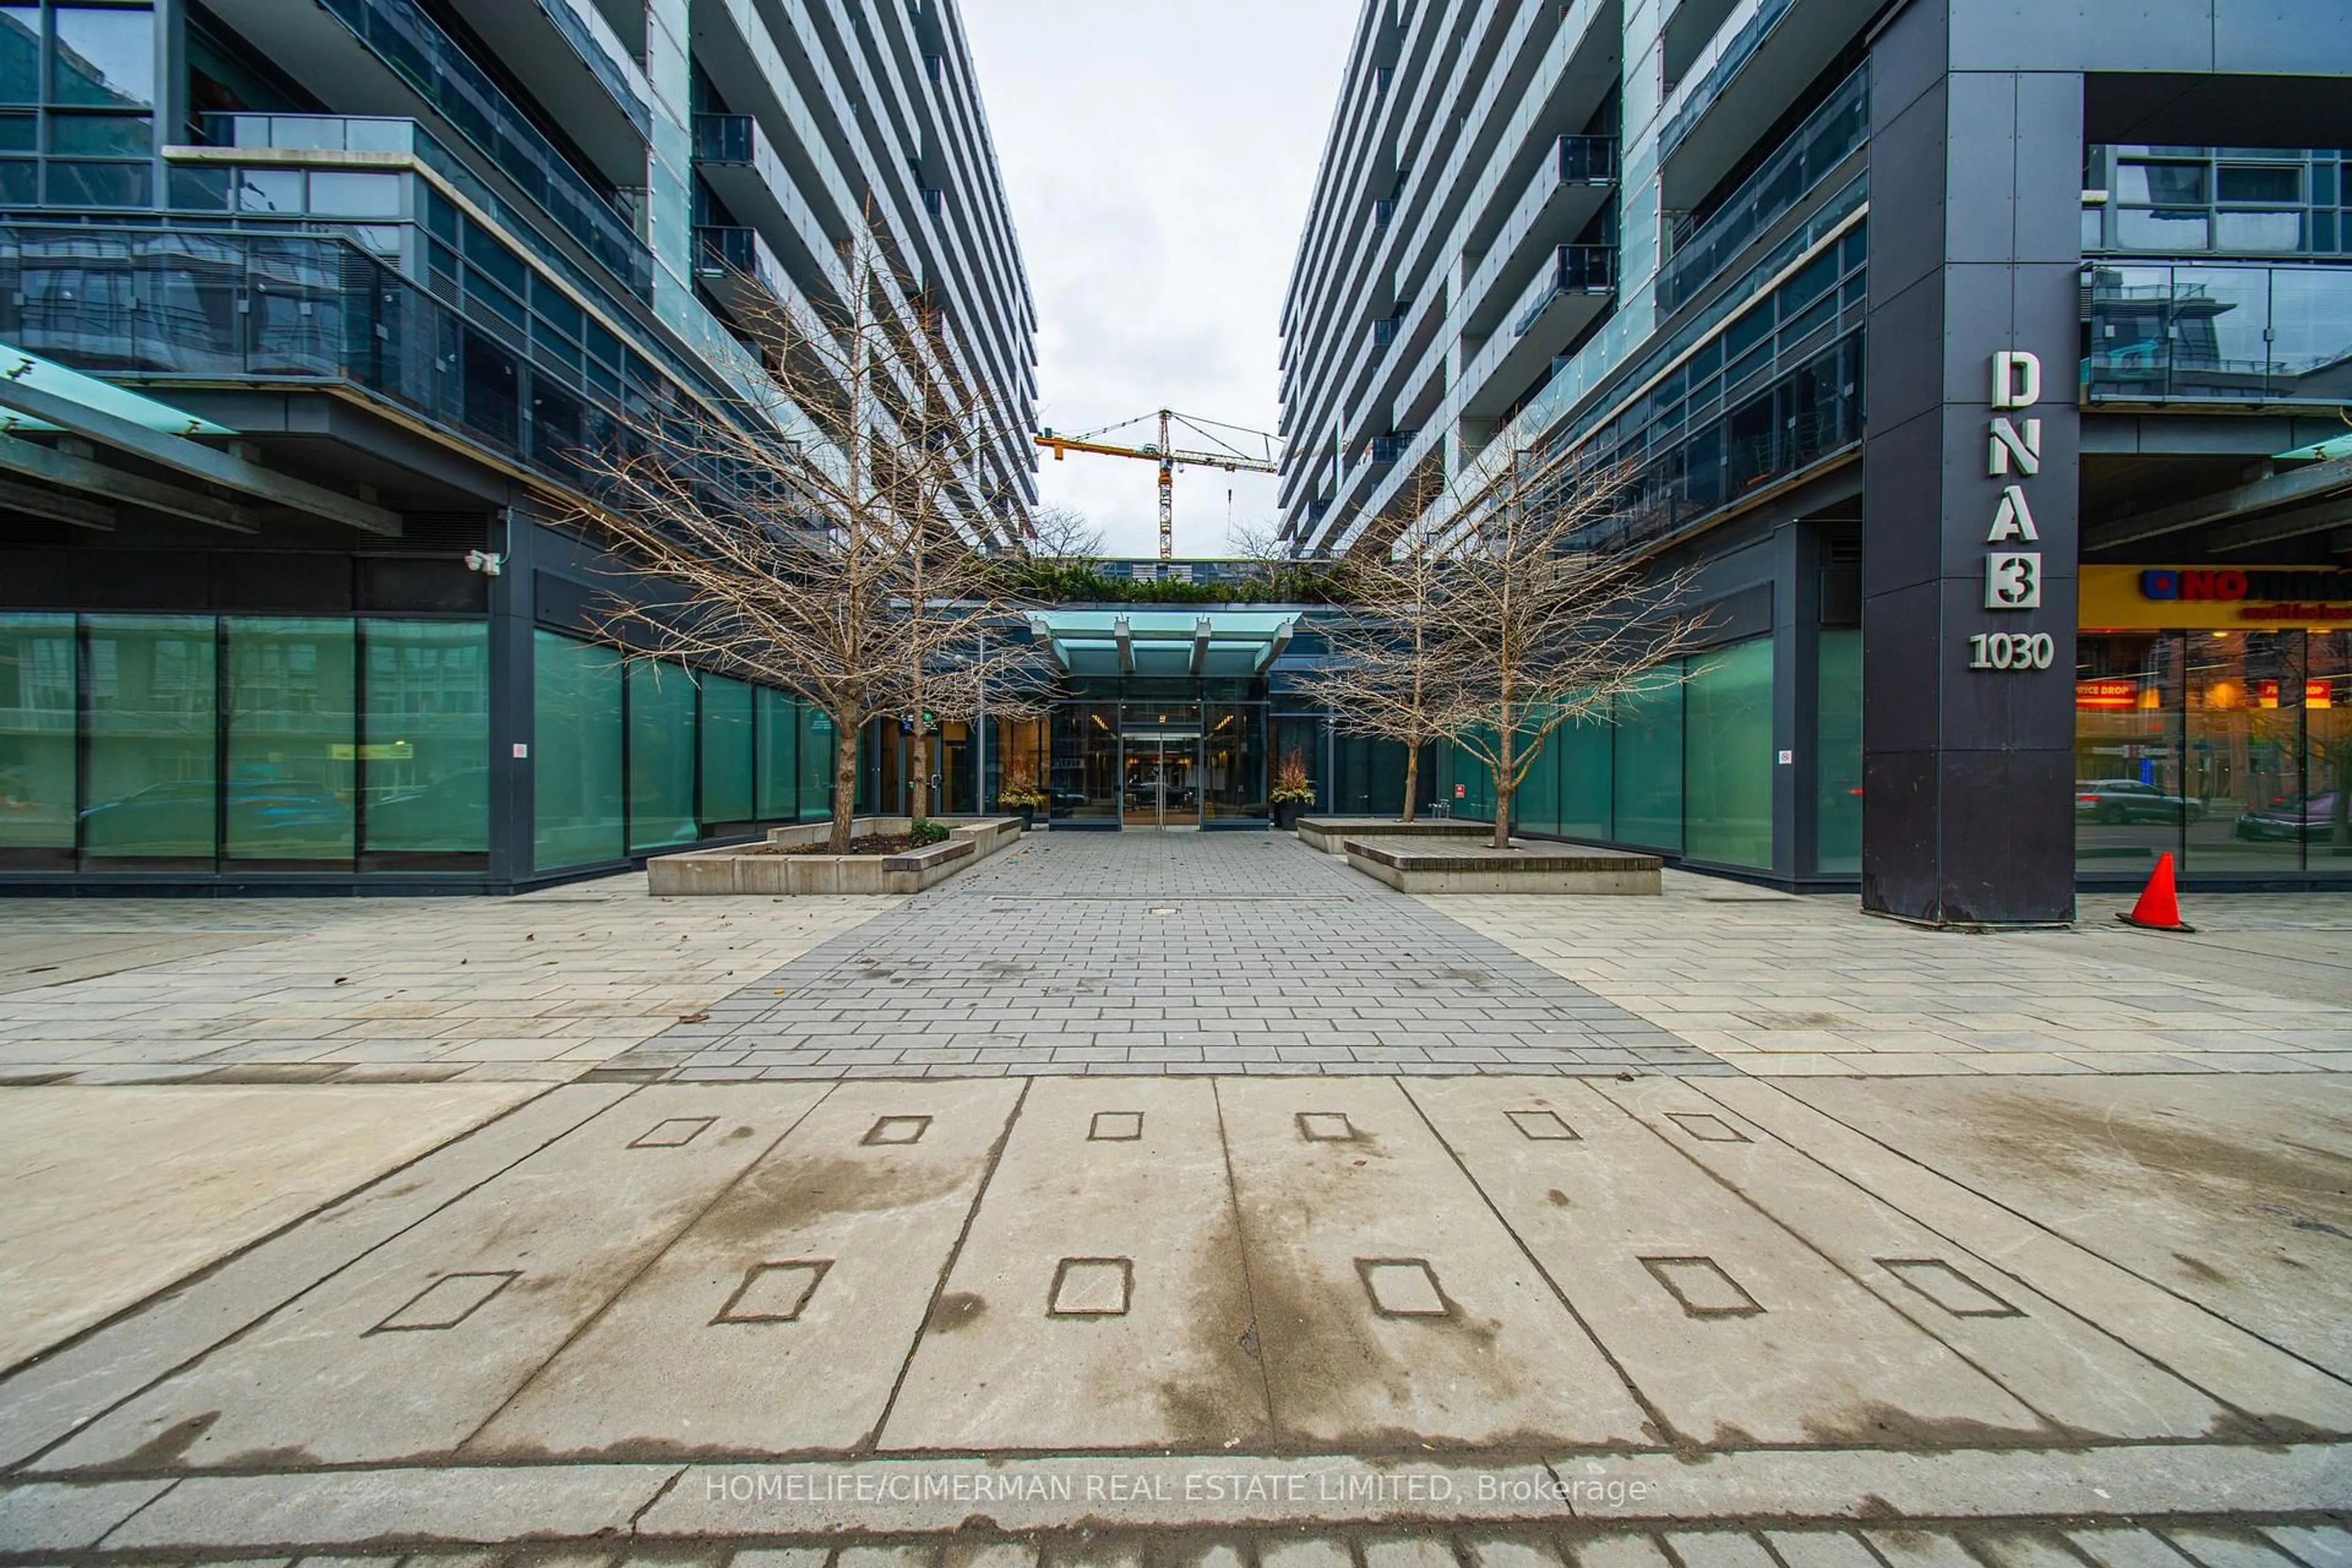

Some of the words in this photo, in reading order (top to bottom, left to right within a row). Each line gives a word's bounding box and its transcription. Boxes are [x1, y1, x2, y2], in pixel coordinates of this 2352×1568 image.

[2179, 570, 2247, 601] NO
[1969, 633, 2054, 670] 1030
[2101, 686, 2129, 695] DROP
